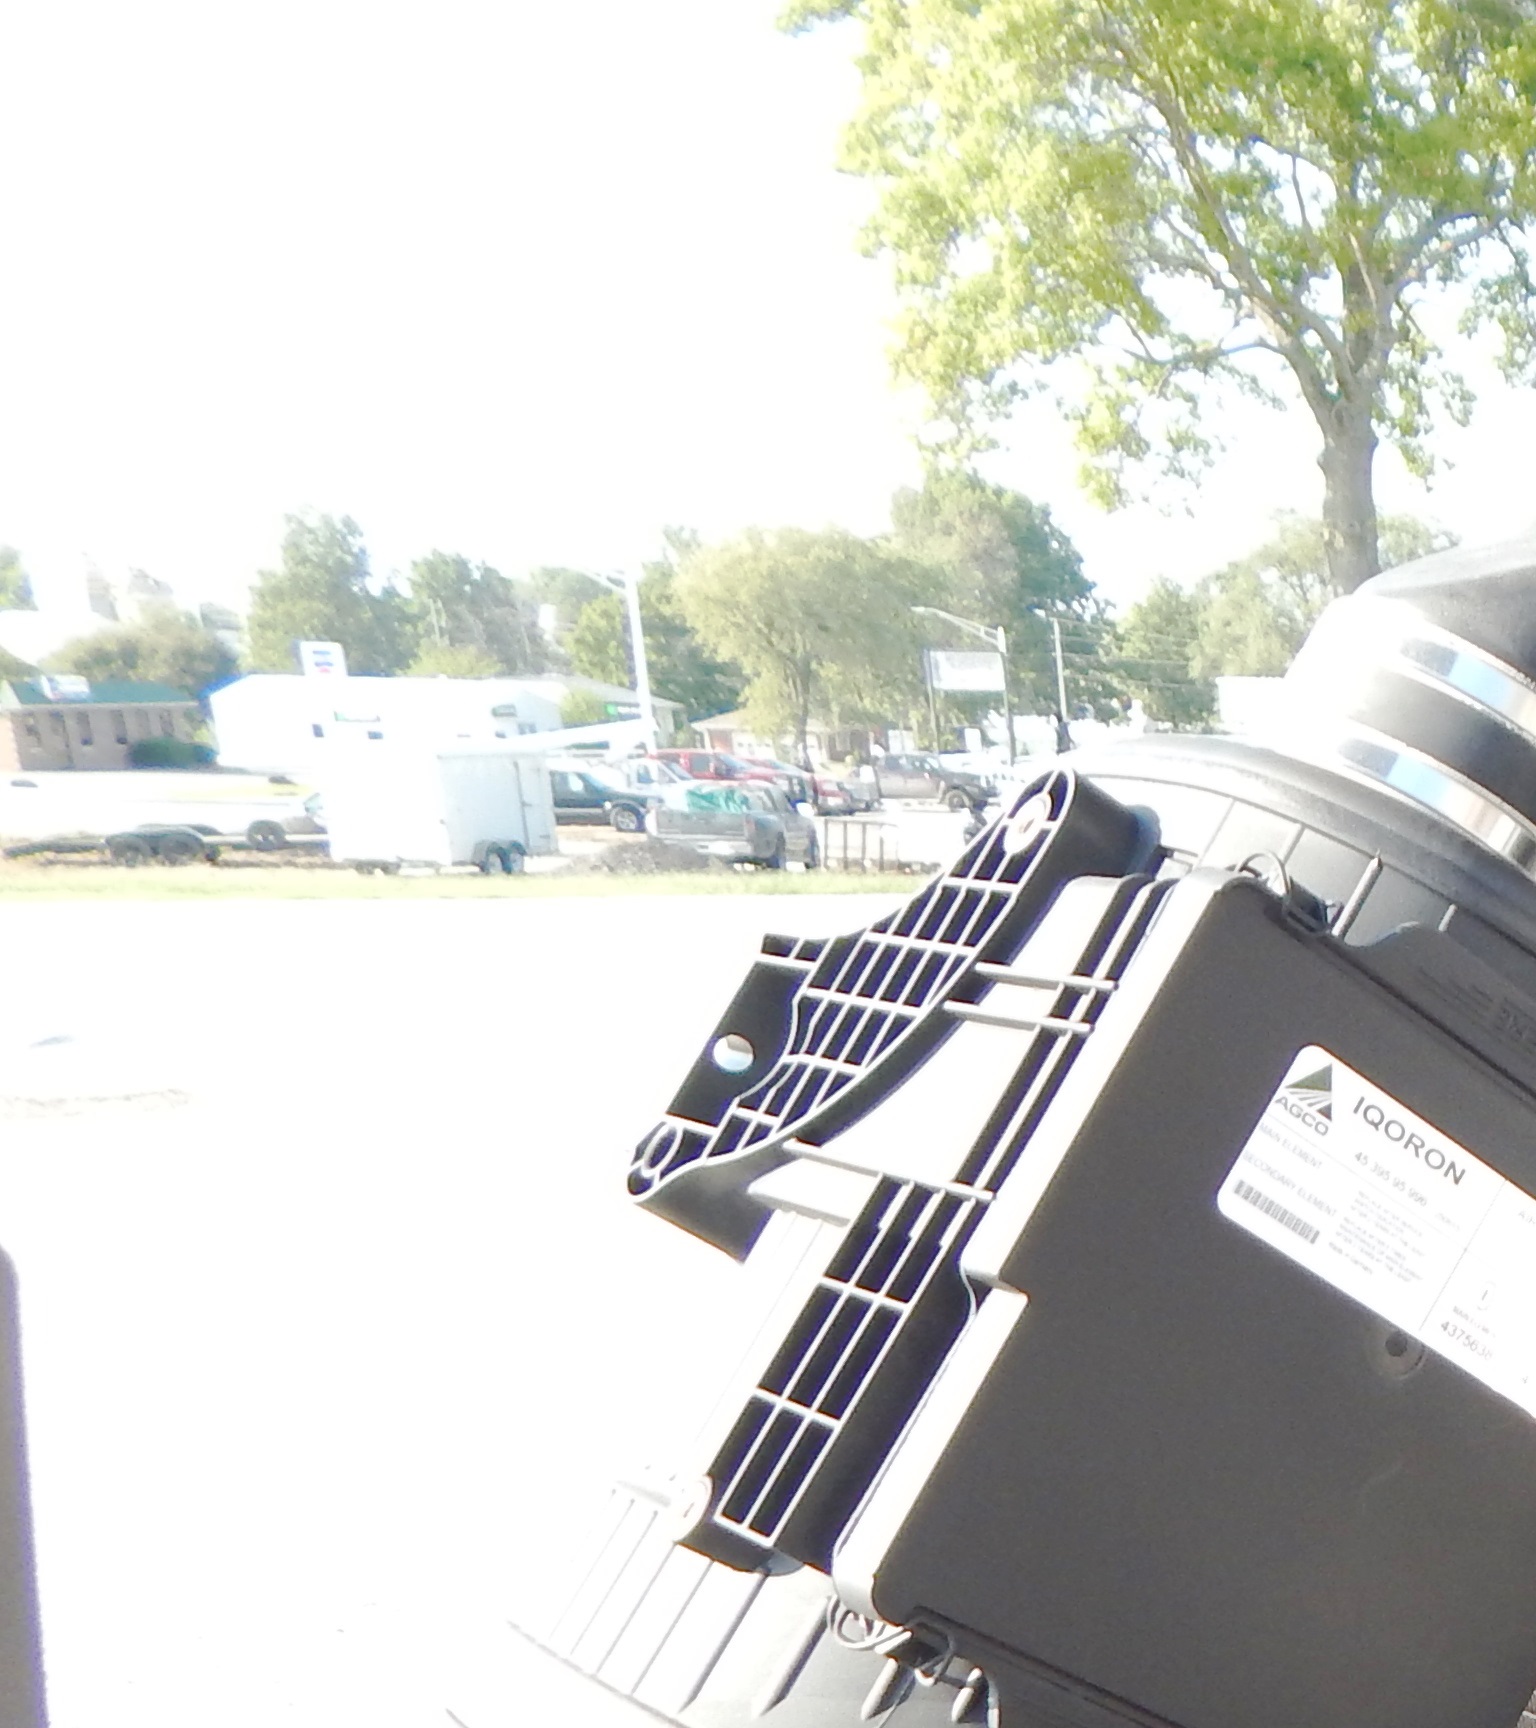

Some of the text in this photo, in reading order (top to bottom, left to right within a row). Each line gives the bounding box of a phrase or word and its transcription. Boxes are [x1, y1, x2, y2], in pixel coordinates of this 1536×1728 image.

[1273, 1092, 1331, 1138] AGCO
[1351, 1094, 1468, 1187] IQORON
[1280, 1137, 1323, 1170] ELEMENT
[1241, 1149, 1337, 1218] SECONDARY ELEMENT
